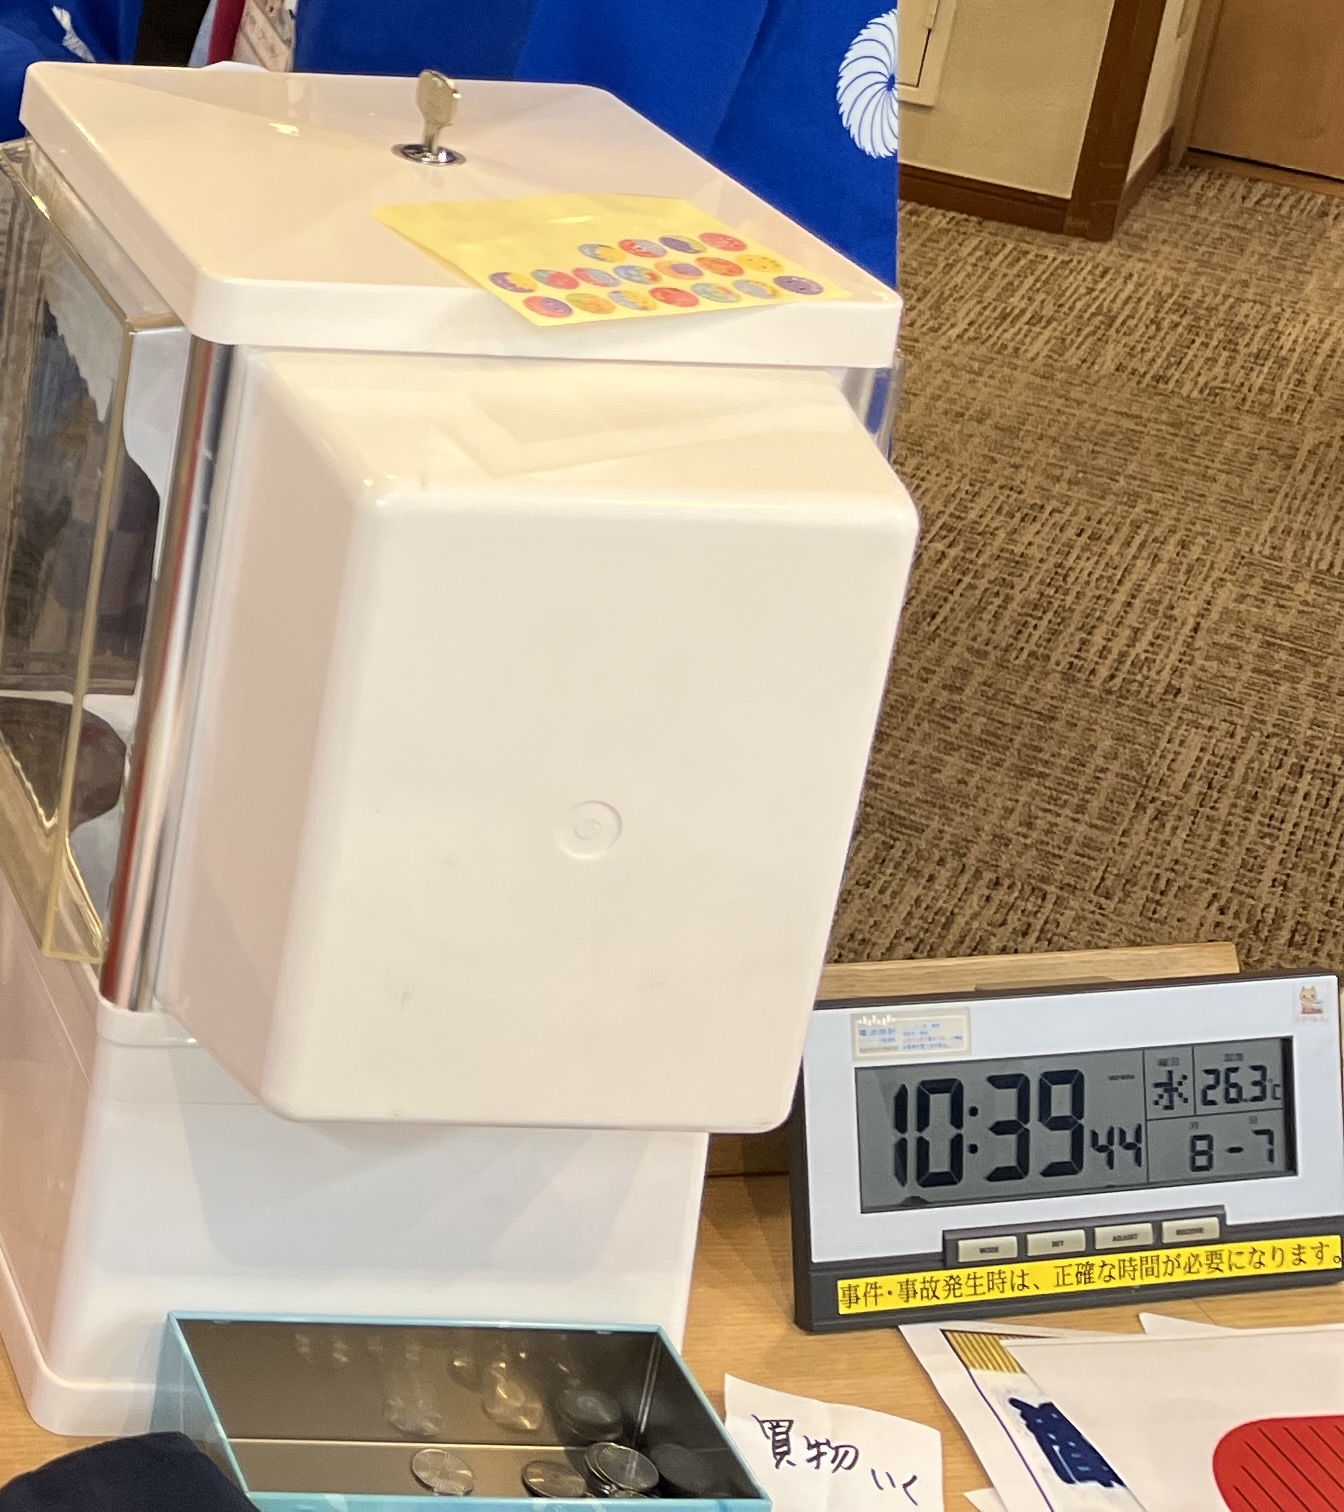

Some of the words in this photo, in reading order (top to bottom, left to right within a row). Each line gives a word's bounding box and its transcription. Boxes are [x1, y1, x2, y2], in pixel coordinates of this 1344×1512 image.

[1152, 1069, 1189, 1111] 水
[890, 1068, 1086, 1190] 10:39
[1089, 1122, 1144, 1172] 44
[839, 1240, 1343, 1311] 事件・事故発生時は、正確な時間が必要になります。
